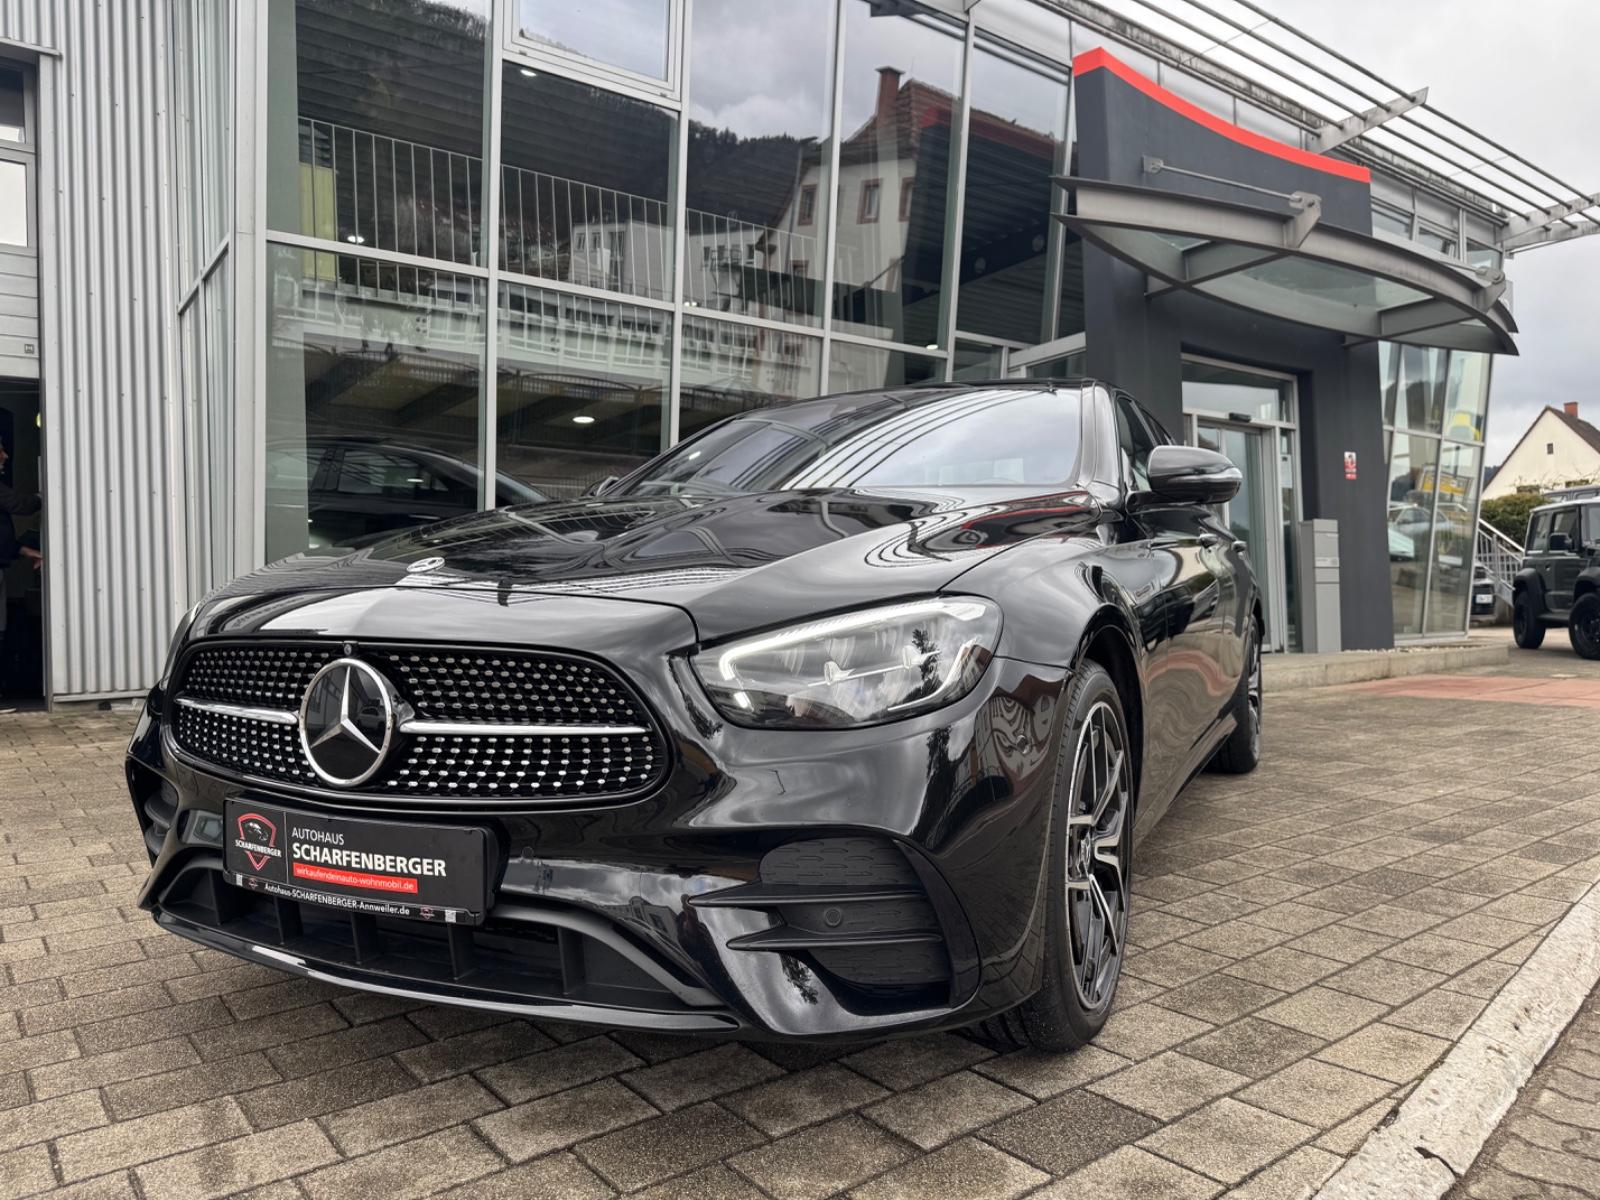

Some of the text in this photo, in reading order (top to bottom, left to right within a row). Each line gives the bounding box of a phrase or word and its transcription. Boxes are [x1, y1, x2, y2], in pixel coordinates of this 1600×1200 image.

[235, 839, 282, 858] SCHARFENBERGER
[292, 827, 345, 845] AUTOHAUS
[292, 842, 447, 877] SCHARFENBERGER
[264, 882, 410, 915] Autohaus-SCHARFENBERGER-Annweiler.de
